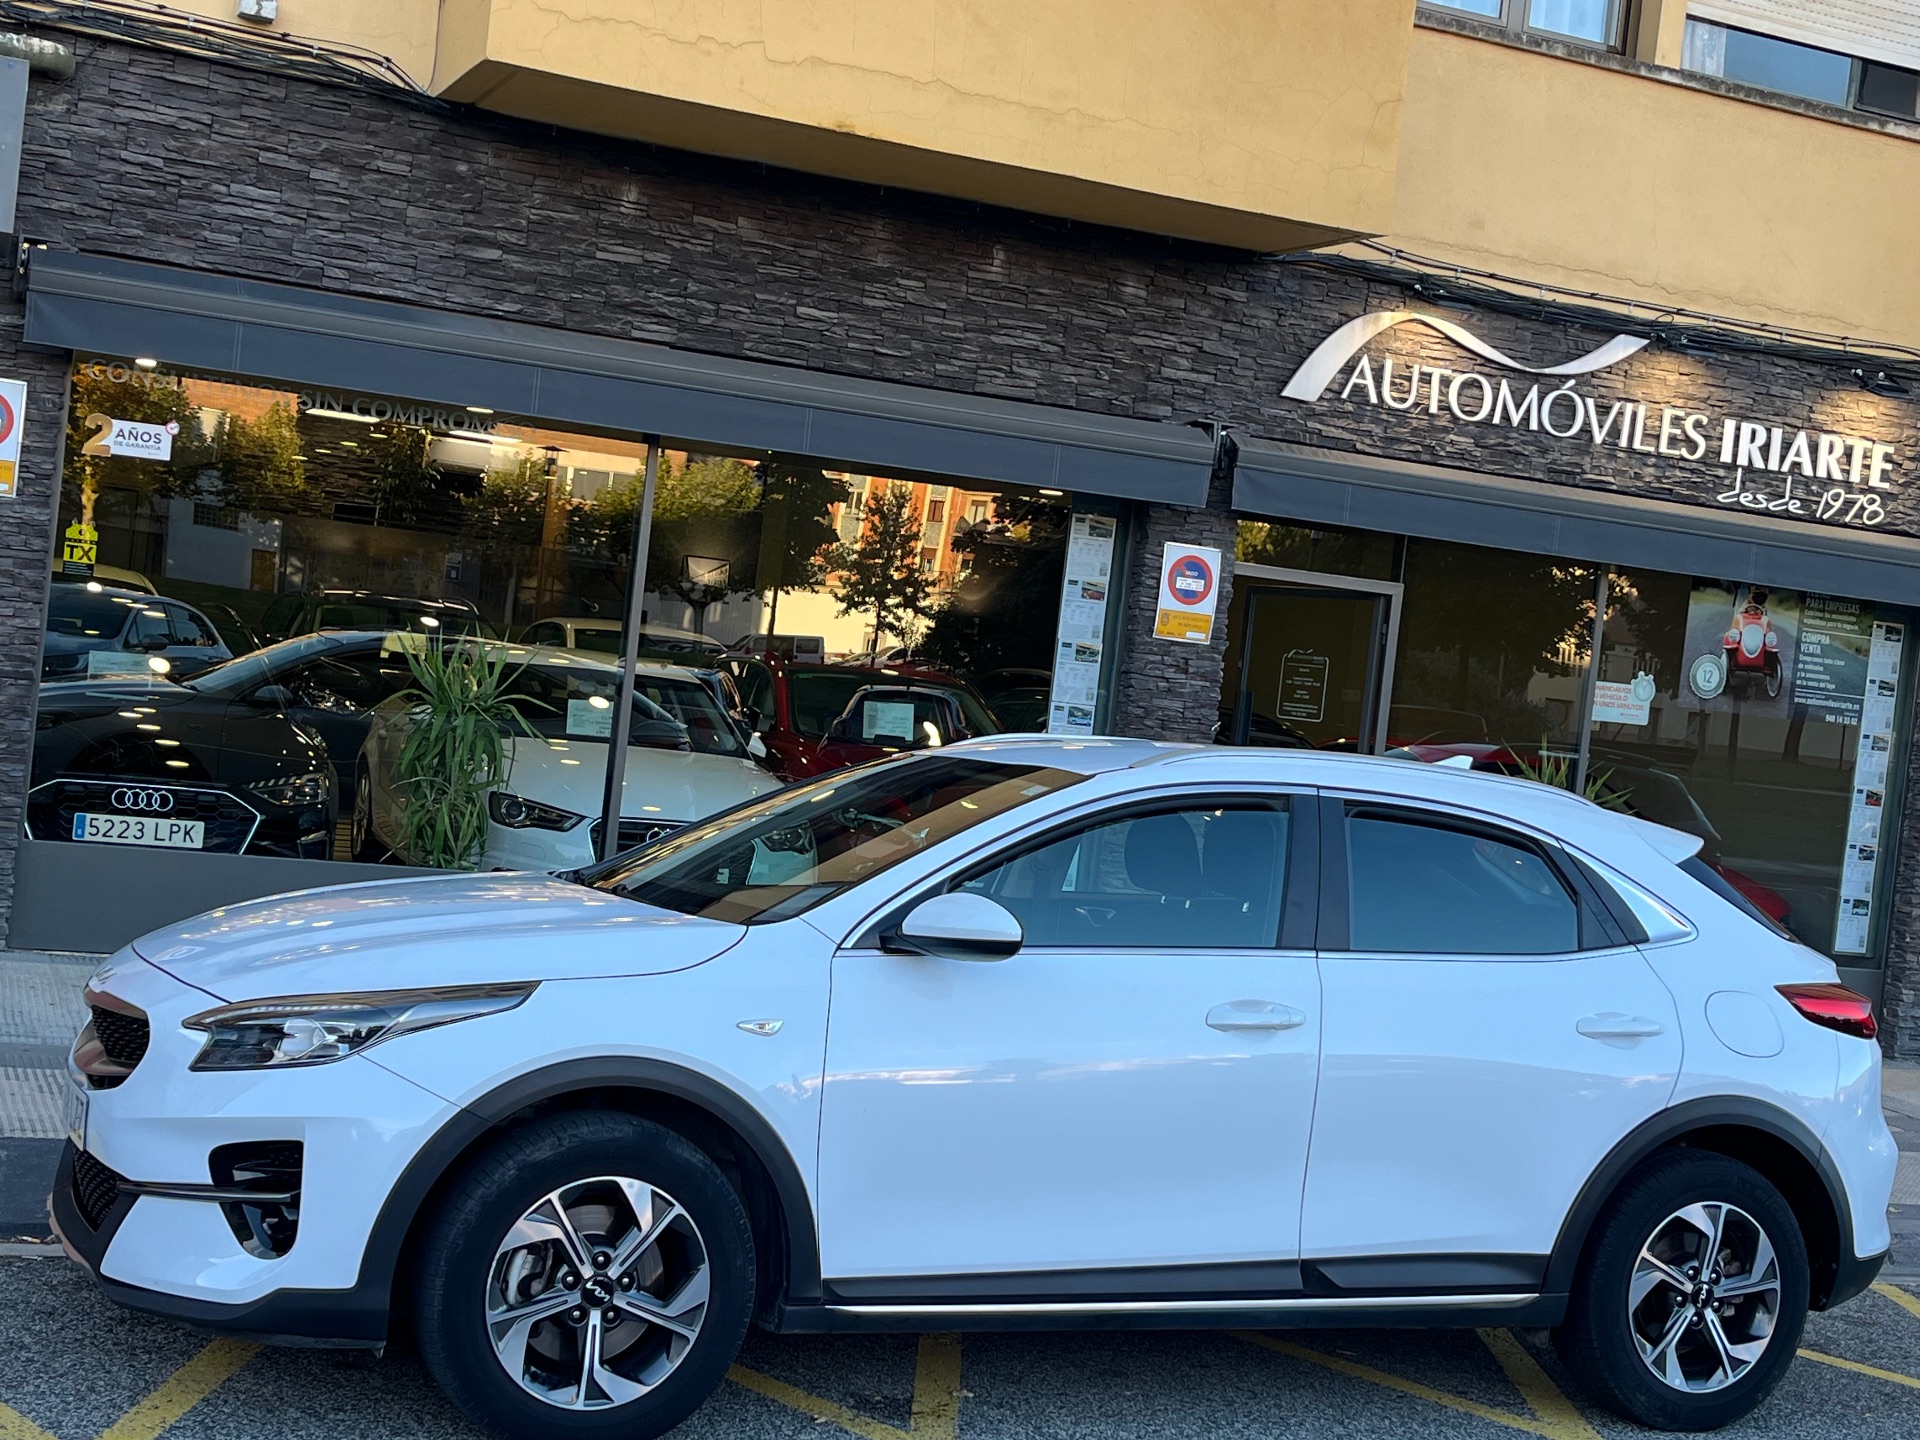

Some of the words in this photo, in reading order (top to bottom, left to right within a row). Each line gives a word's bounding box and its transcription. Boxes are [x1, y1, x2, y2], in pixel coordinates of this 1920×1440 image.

[299, 389, 343, 412] SIN
[1341, 354, 1709, 461] AUTOMÓVILES
[1719, 418, 1896, 490] IRIARTE
[81, 413, 113, 458] 2
[115, 427, 162, 444] AÑOS
[1716, 467, 1804, 514] desde
[1815, 487, 1885, 525] 1978
[66, 544, 93, 562] TX
[1805, 597, 1823, 609] PARA
[1825, 601, 1860, 614] EMPRESAS
[1801, 632, 1830, 645] COMPRA
[1800, 643, 1821, 655] VENTA
[1702, 669, 1714, 684] 12
[1836, 715, 1843, 723] 14
[88, 817, 145, 840] 5223
[154, 822, 196, 843] LPK
